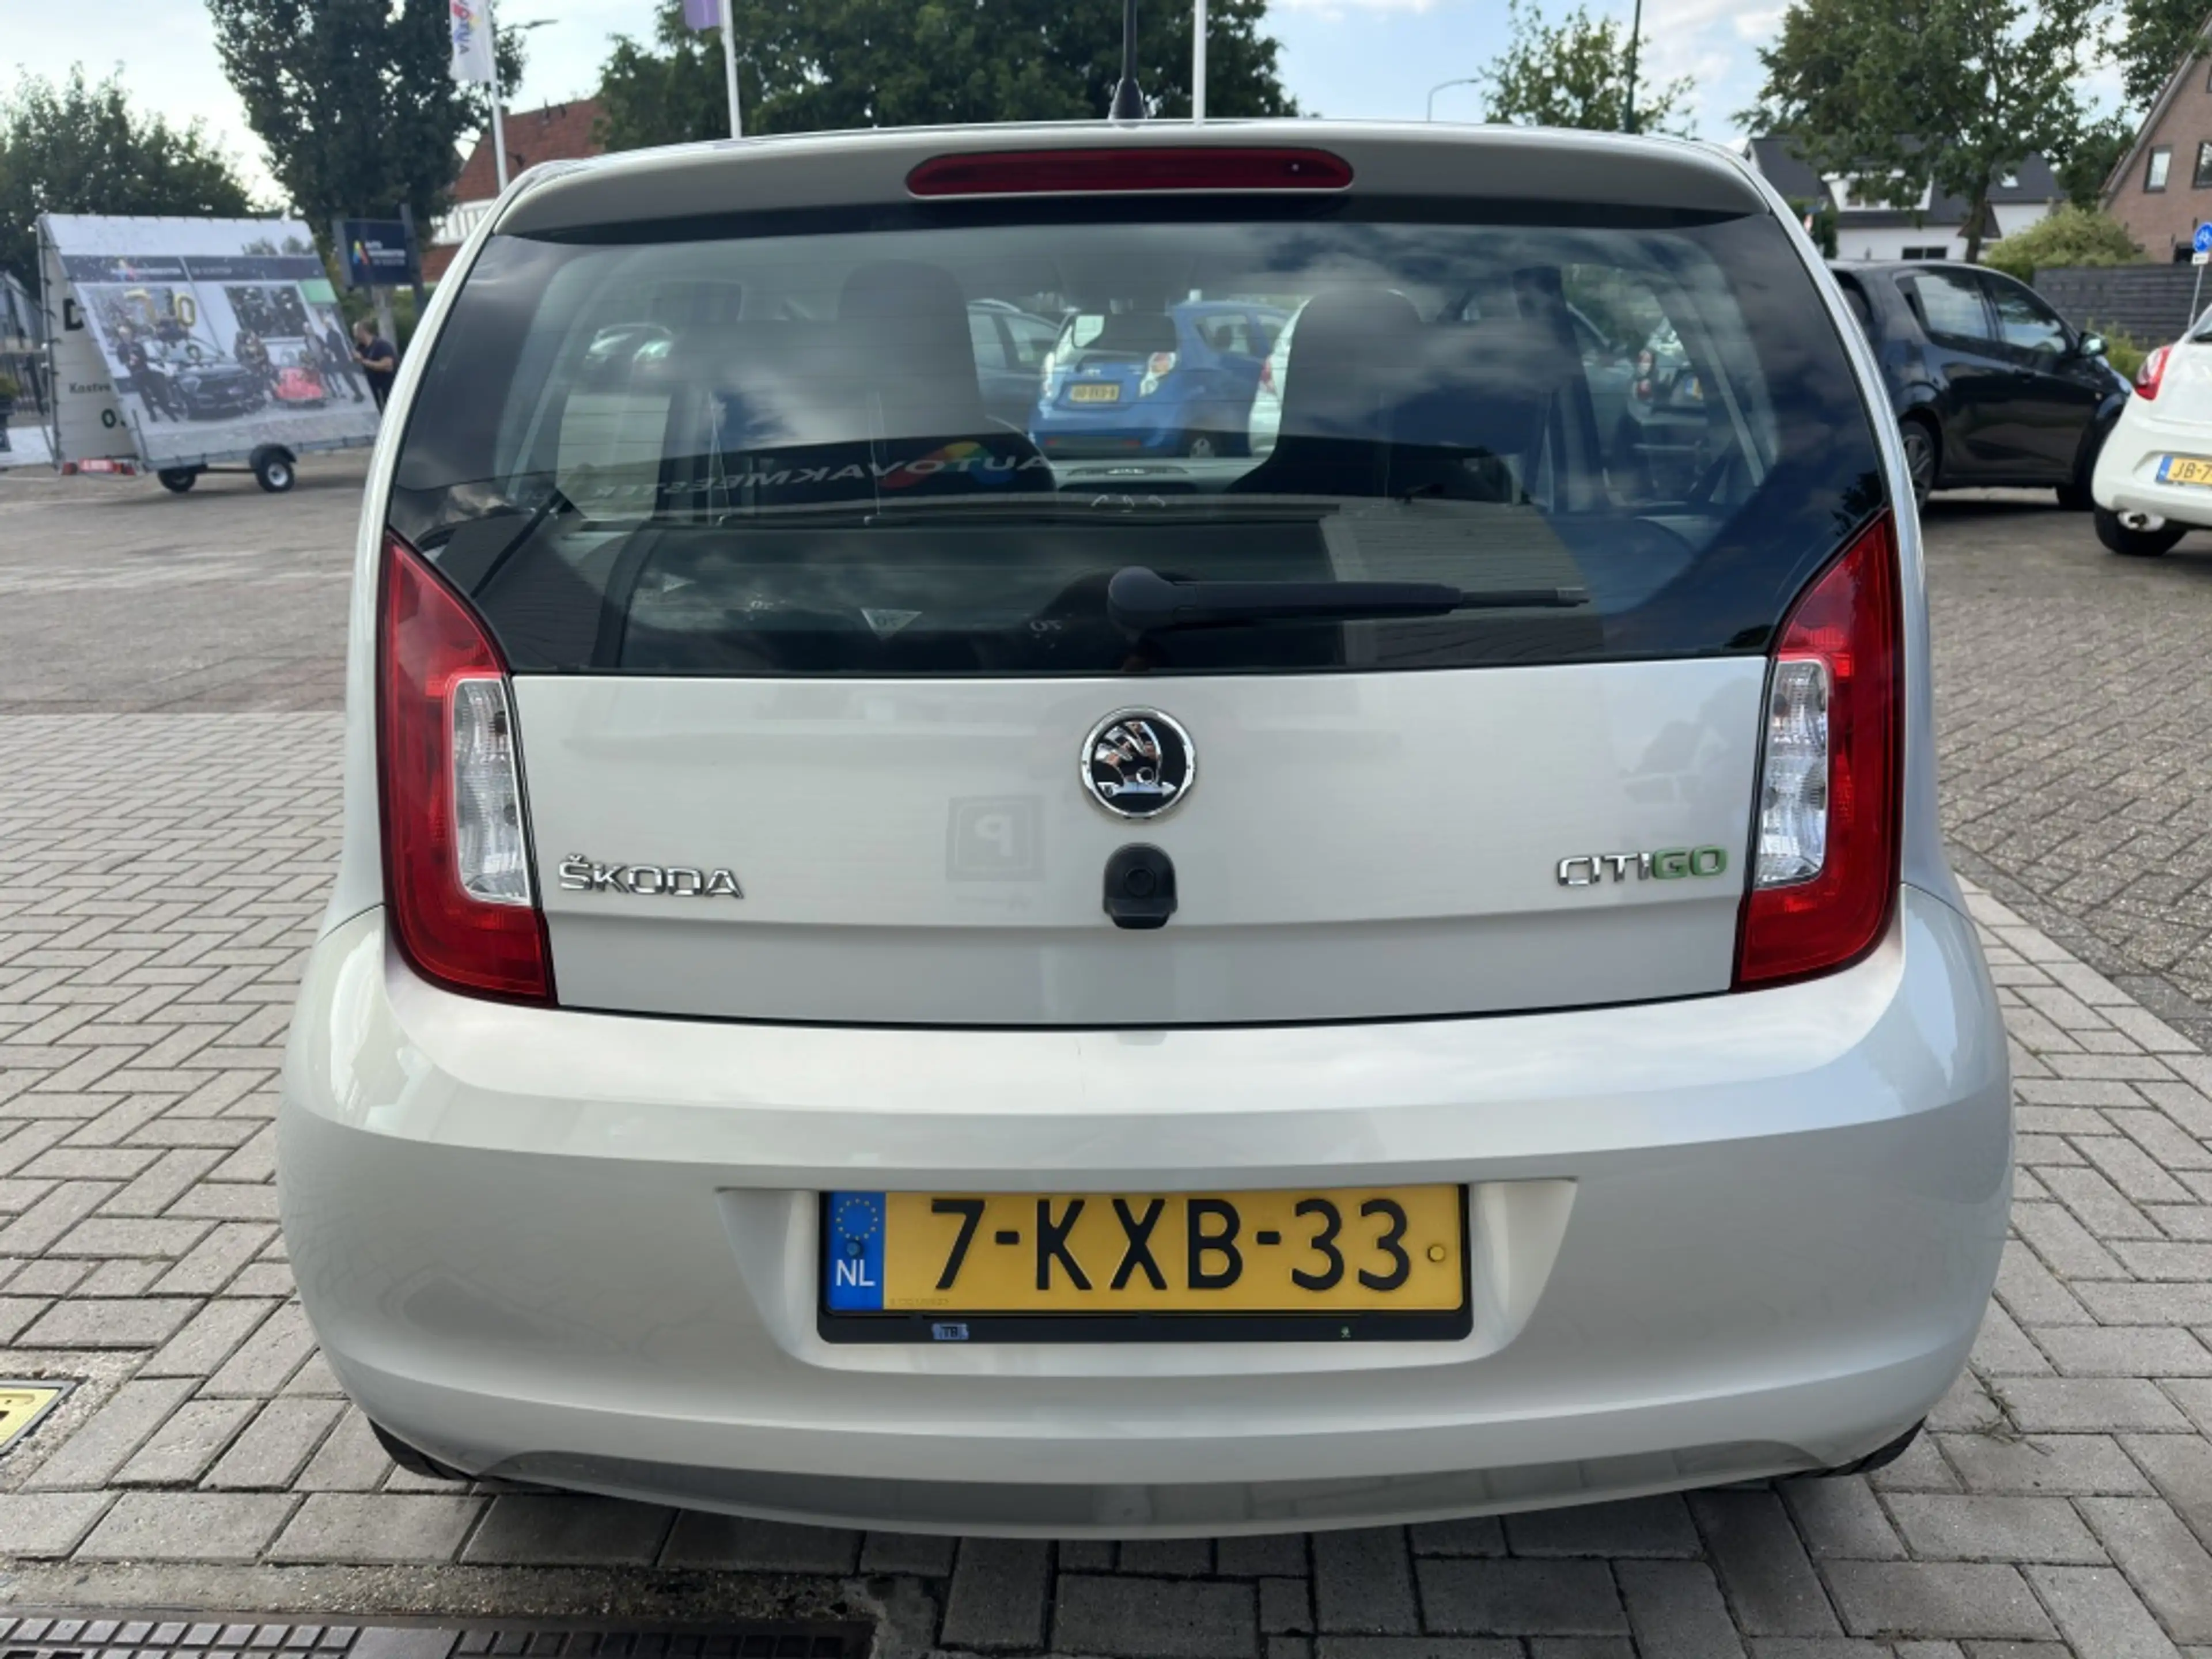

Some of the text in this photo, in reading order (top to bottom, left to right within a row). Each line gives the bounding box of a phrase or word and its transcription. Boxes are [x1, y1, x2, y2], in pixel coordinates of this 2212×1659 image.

[558, 853, 744, 899] ŠKODA
[1556, 845, 1728, 887] CITIGO
[930, 1198, 1411, 1291] 7-KXB-33
[836, 1259, 876, 1287] NL
